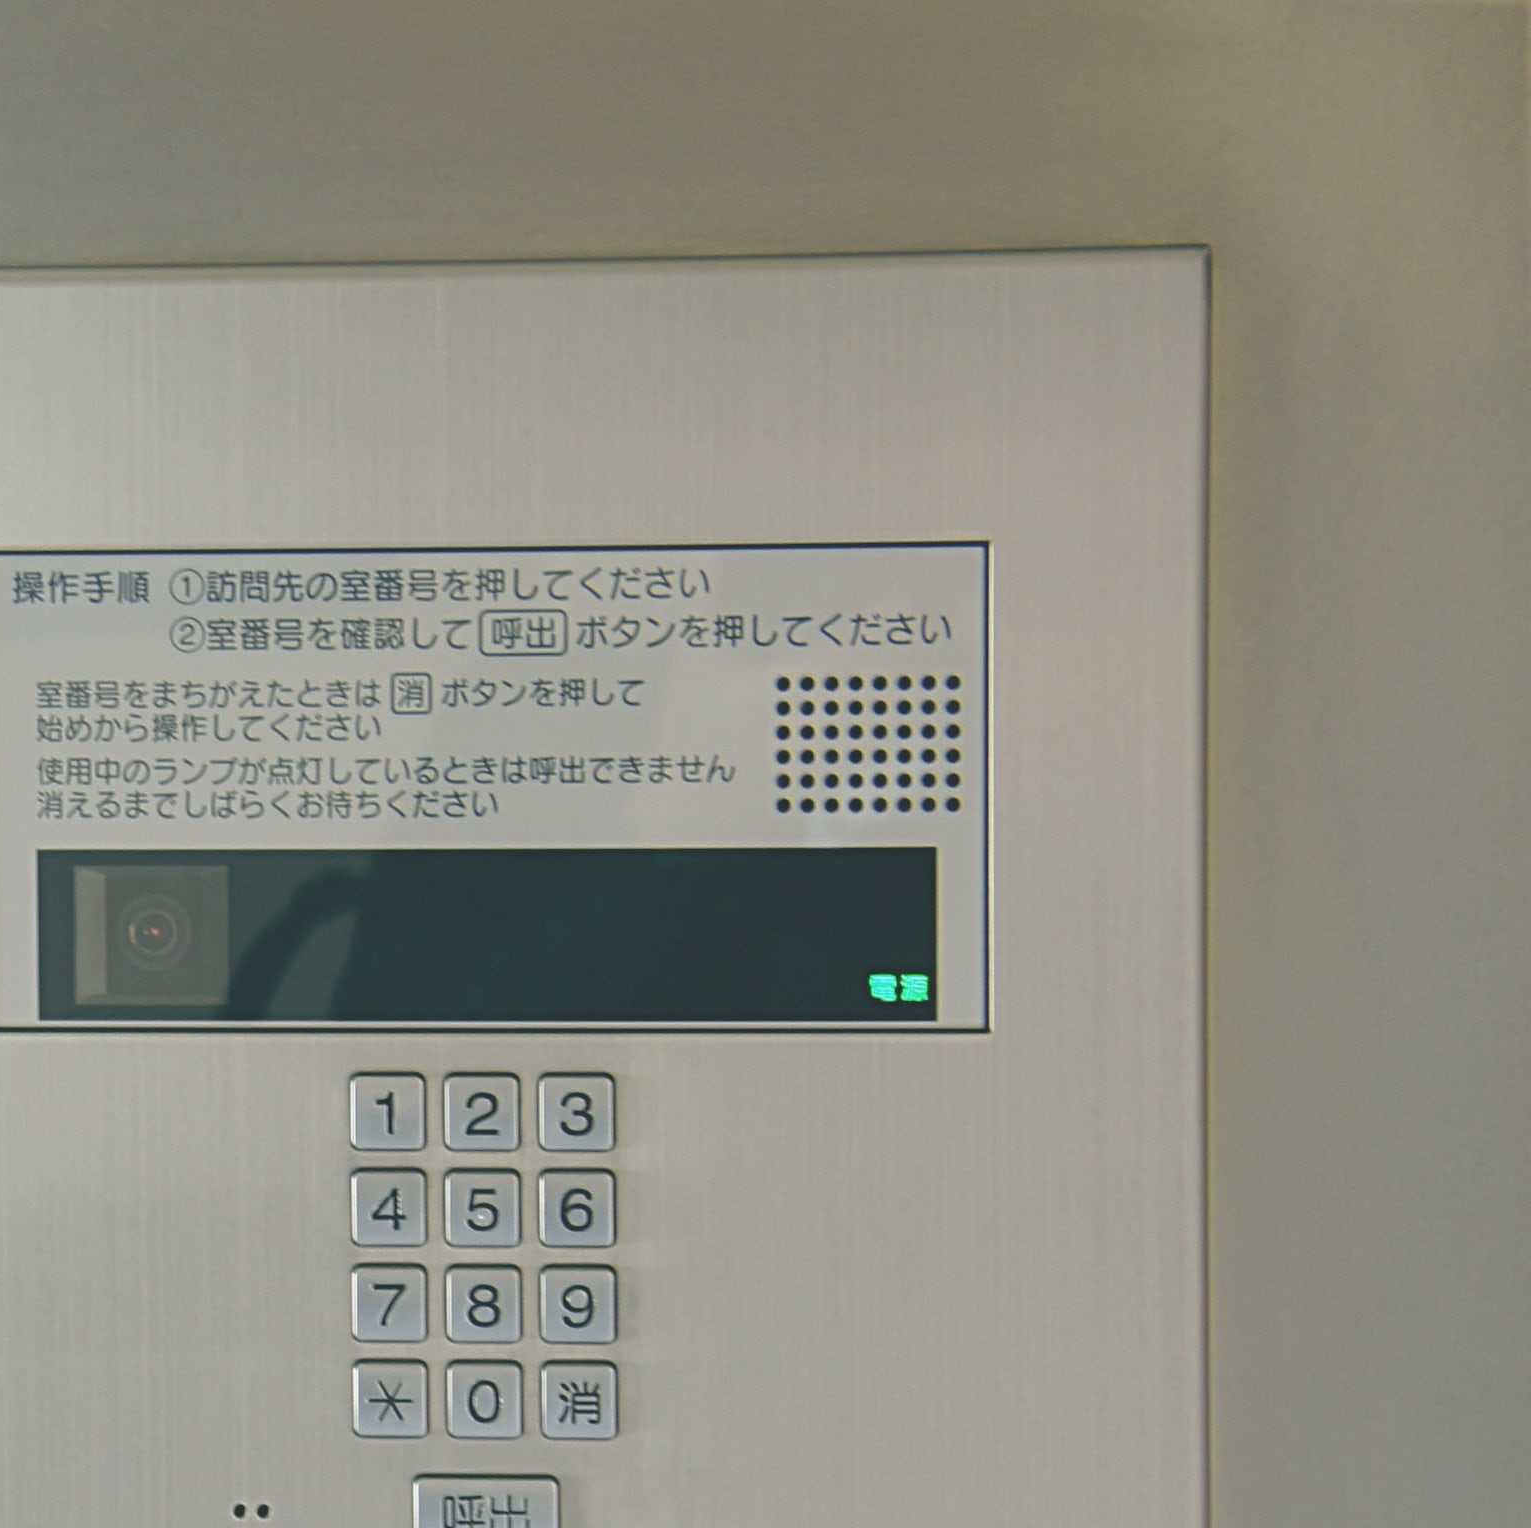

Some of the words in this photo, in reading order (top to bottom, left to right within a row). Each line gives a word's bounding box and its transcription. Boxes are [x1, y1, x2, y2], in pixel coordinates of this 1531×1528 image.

[12, 570, 151, 604] 操作手順
[492, 617, 556, 650] 呼出
[576, 612, 952, 650] ボタンを押してください
[36, 679, 382, 709] 室番号をまちがえたときは
[398, 680, 424, 708] 消
[441, 677, 645, 708] ボタンを押して
[36, 713, 382, 743] 始めから操作してください
[37, 754, 736, 786] 使用中のランプが点灯しているときは呼出できません
[37, 789, 500, 820] 消えるまでしばらくお待ちください
[868, 973, 929, 1002] 電源
[375, 1091, 395, 1135] 1
[465, 1091, 500, 1136] 2
[559, 1091, 595, 1137] 3
[371, 1187, 407, 1231] 4
[466, 1188, 500, 1232] 5
[559, 1187, 595, 1233] 6
[372, 1283, 407, 1327] 7
[467, 1283, 502, 1329] 8
[561, 1284, 596, 1329] 9
[467, 1379, 502, 1424] 0
[557, 1380, 603, 1426] 消
